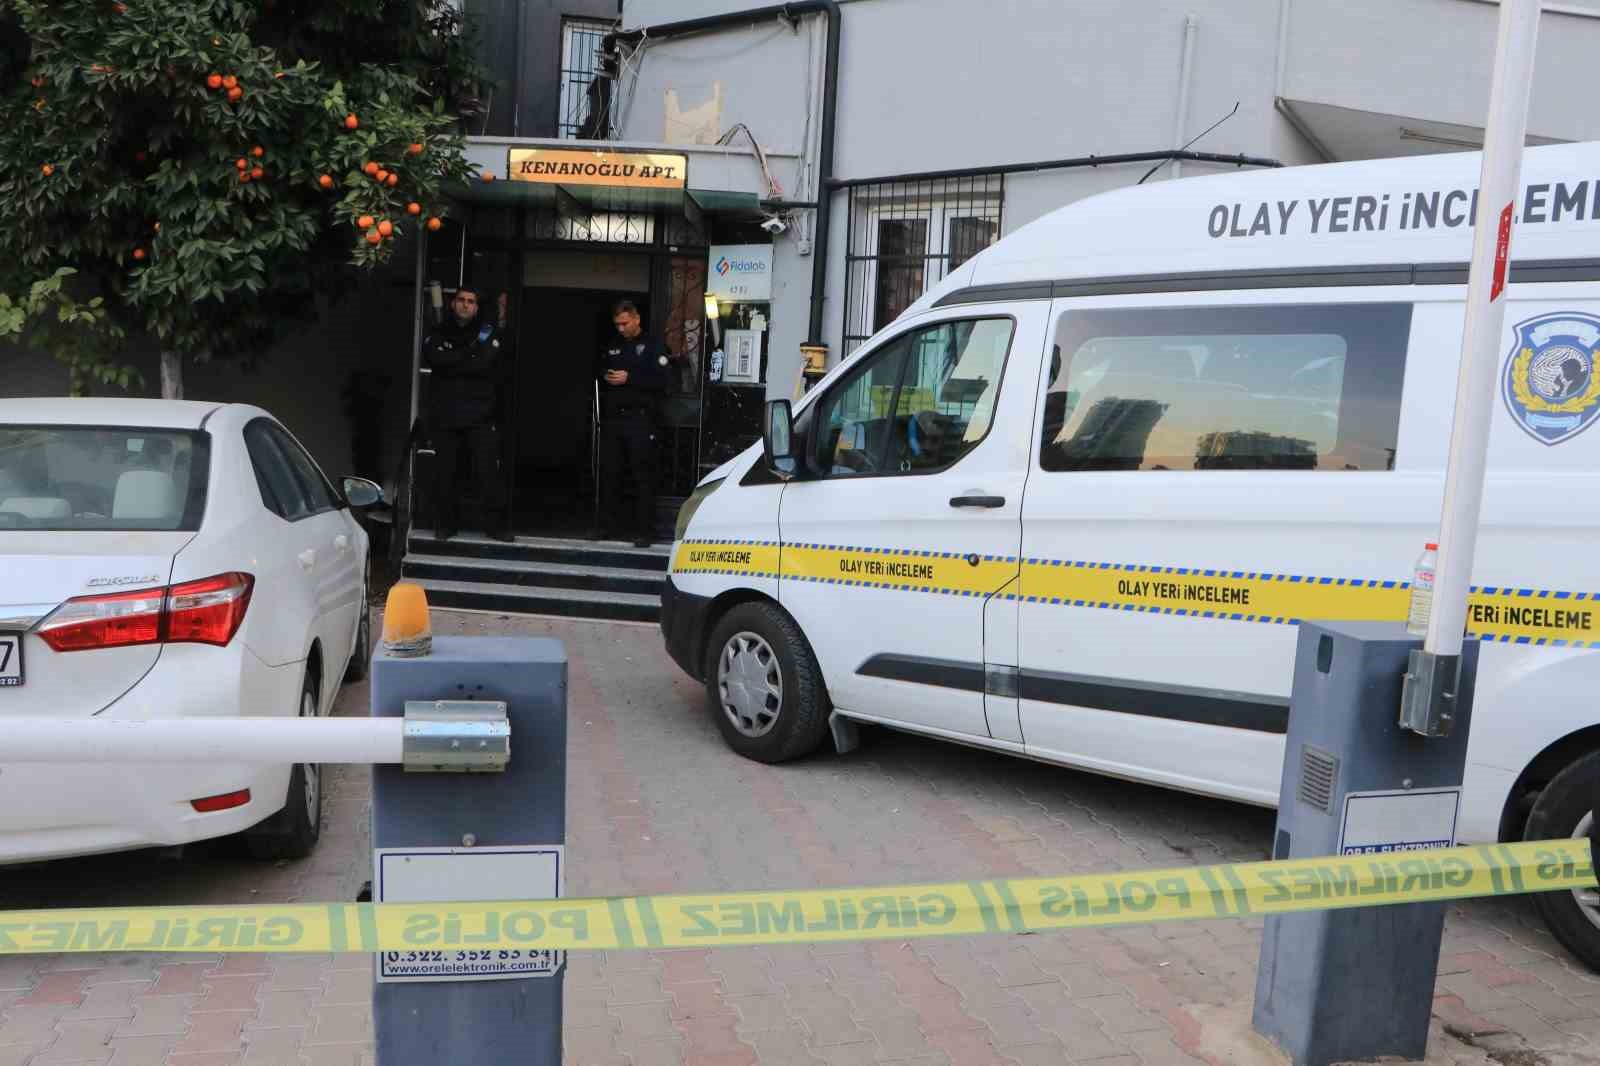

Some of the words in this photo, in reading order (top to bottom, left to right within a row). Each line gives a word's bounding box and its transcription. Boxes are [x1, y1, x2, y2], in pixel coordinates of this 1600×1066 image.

[639, 166, 677, 179] APT.
[1208, 200, 1298, 238] OLAY
[690, 551, 704, 562] OLAY
[840, 559, 861, 572] OLAY
[1118, 580, 1149, 596] OLAY
[388, 960, 550, 974] www.orelelektronik.com.tr
